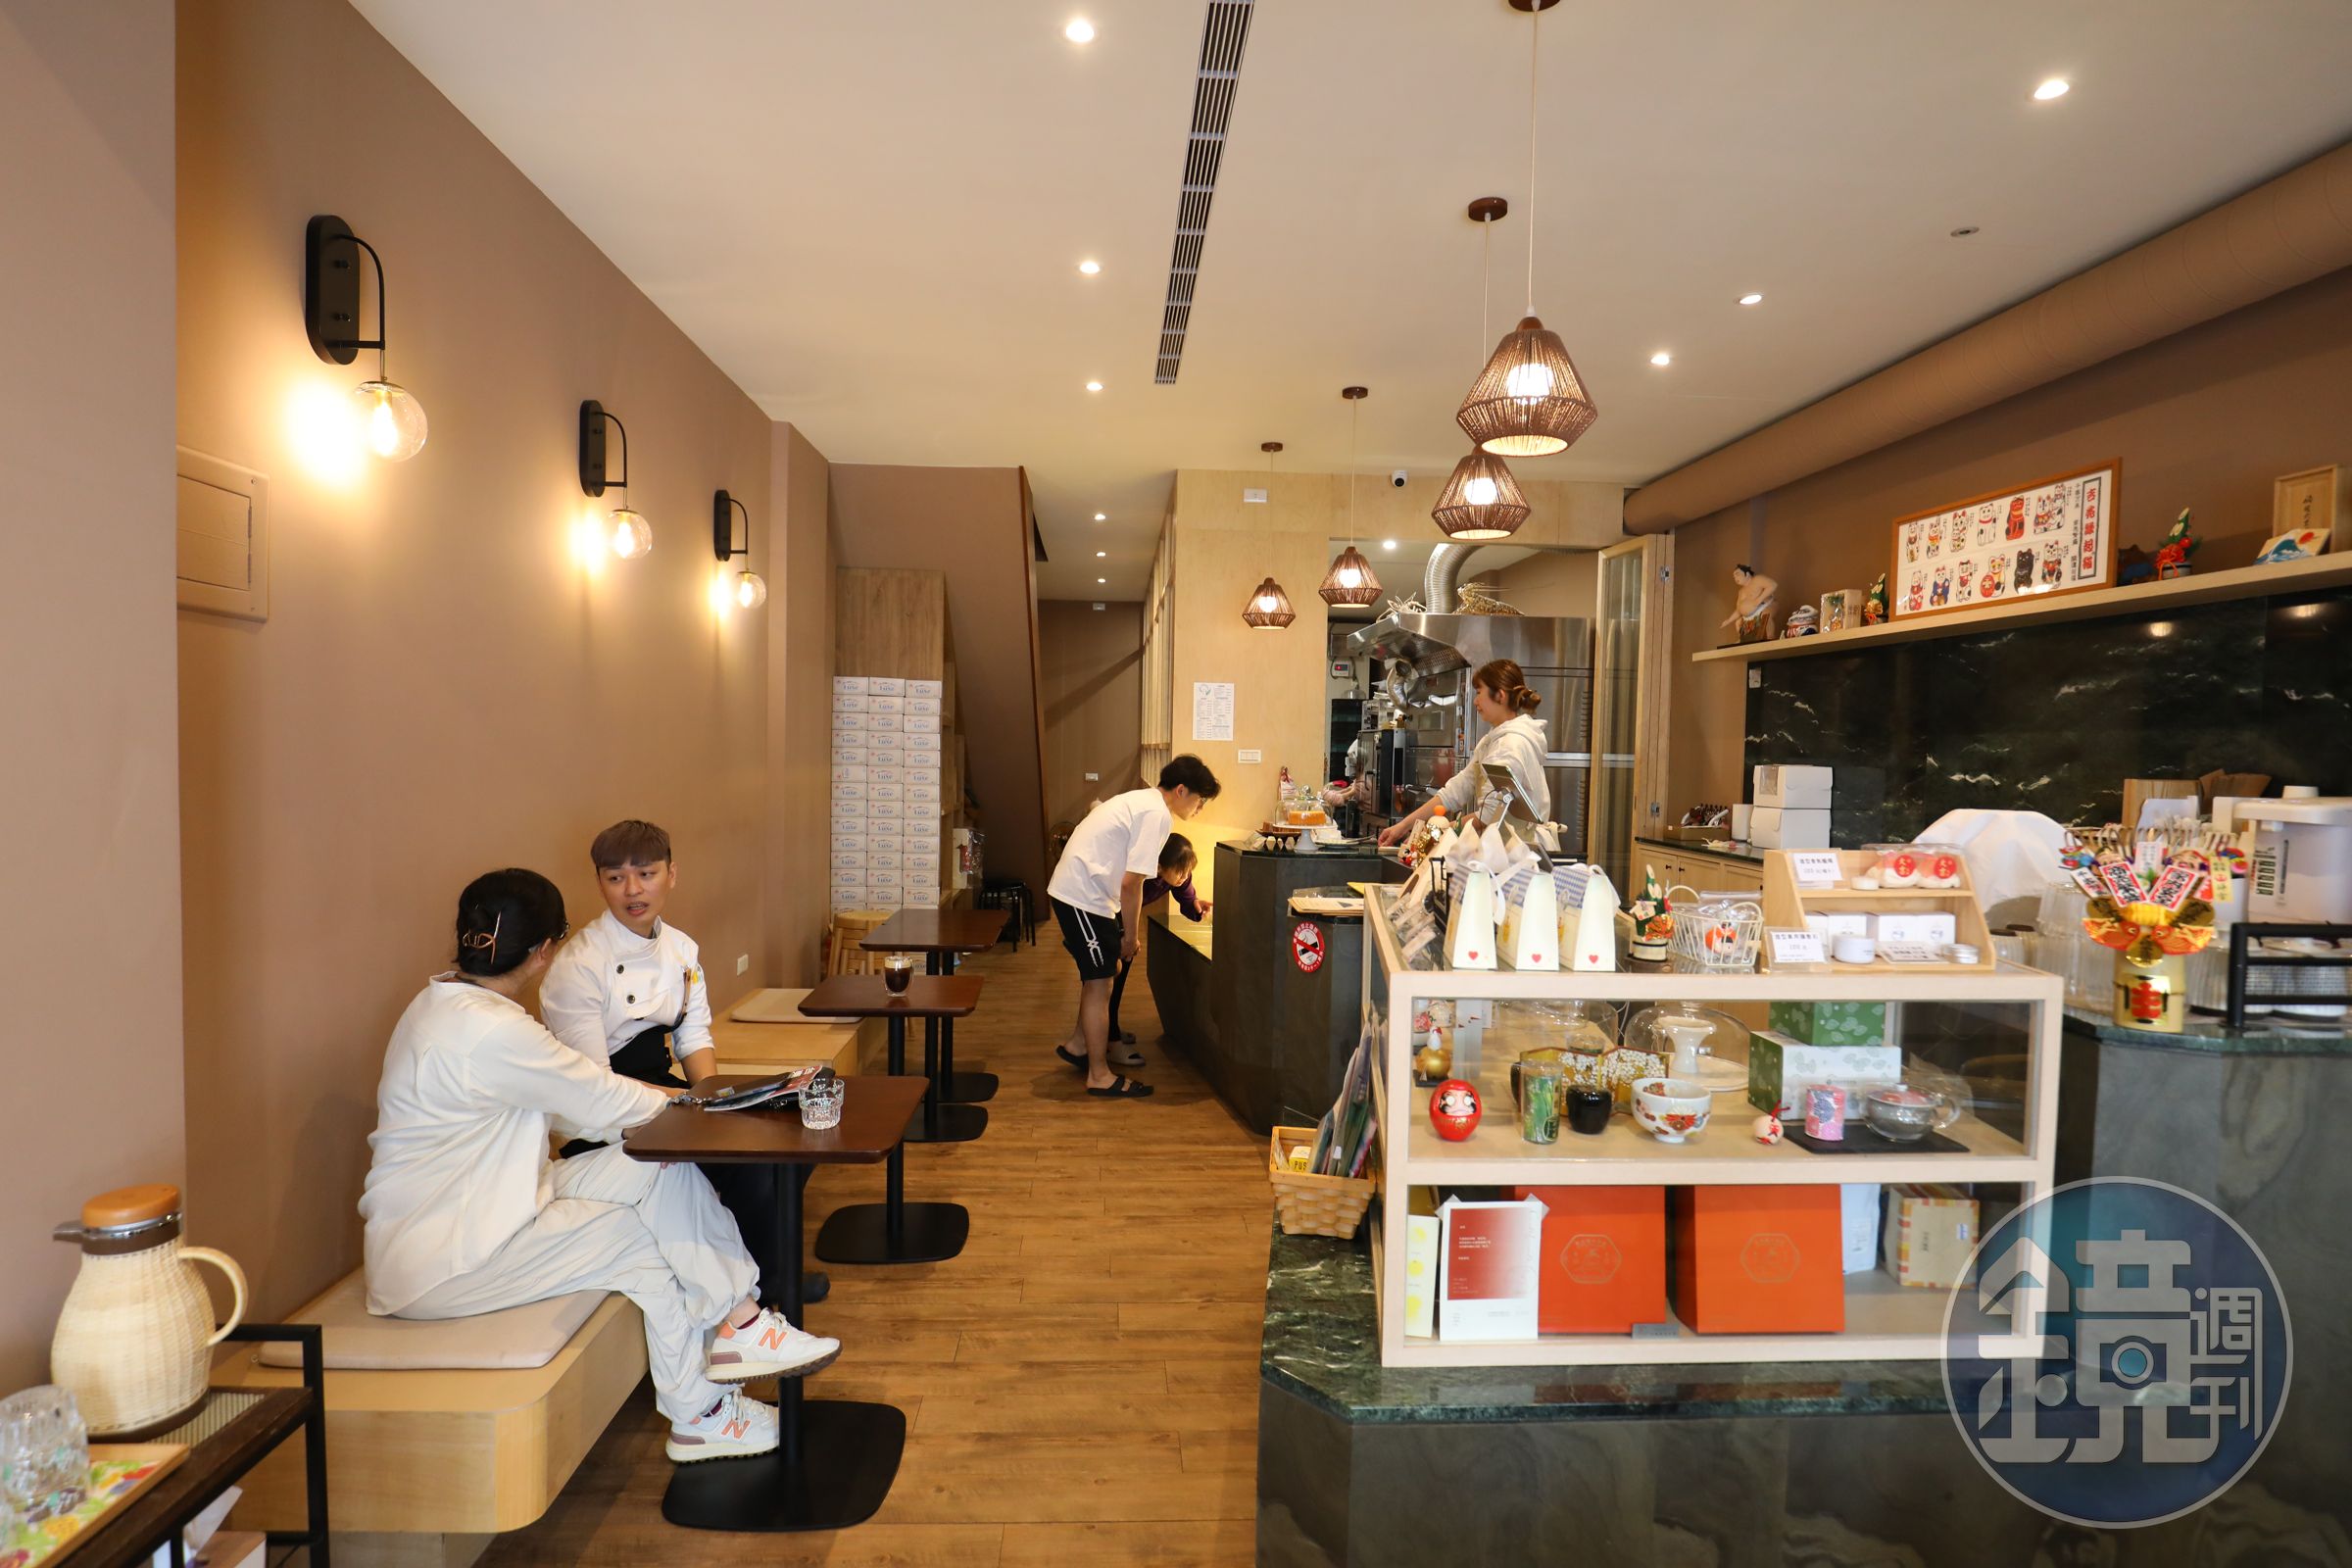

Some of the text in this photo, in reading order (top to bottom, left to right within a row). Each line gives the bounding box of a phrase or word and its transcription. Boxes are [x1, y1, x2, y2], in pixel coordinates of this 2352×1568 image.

[1294, 1160, 1309, 1170] PUS
[758, 1327, 788, 1350] N
[720, 1419, 752, 1440] N
